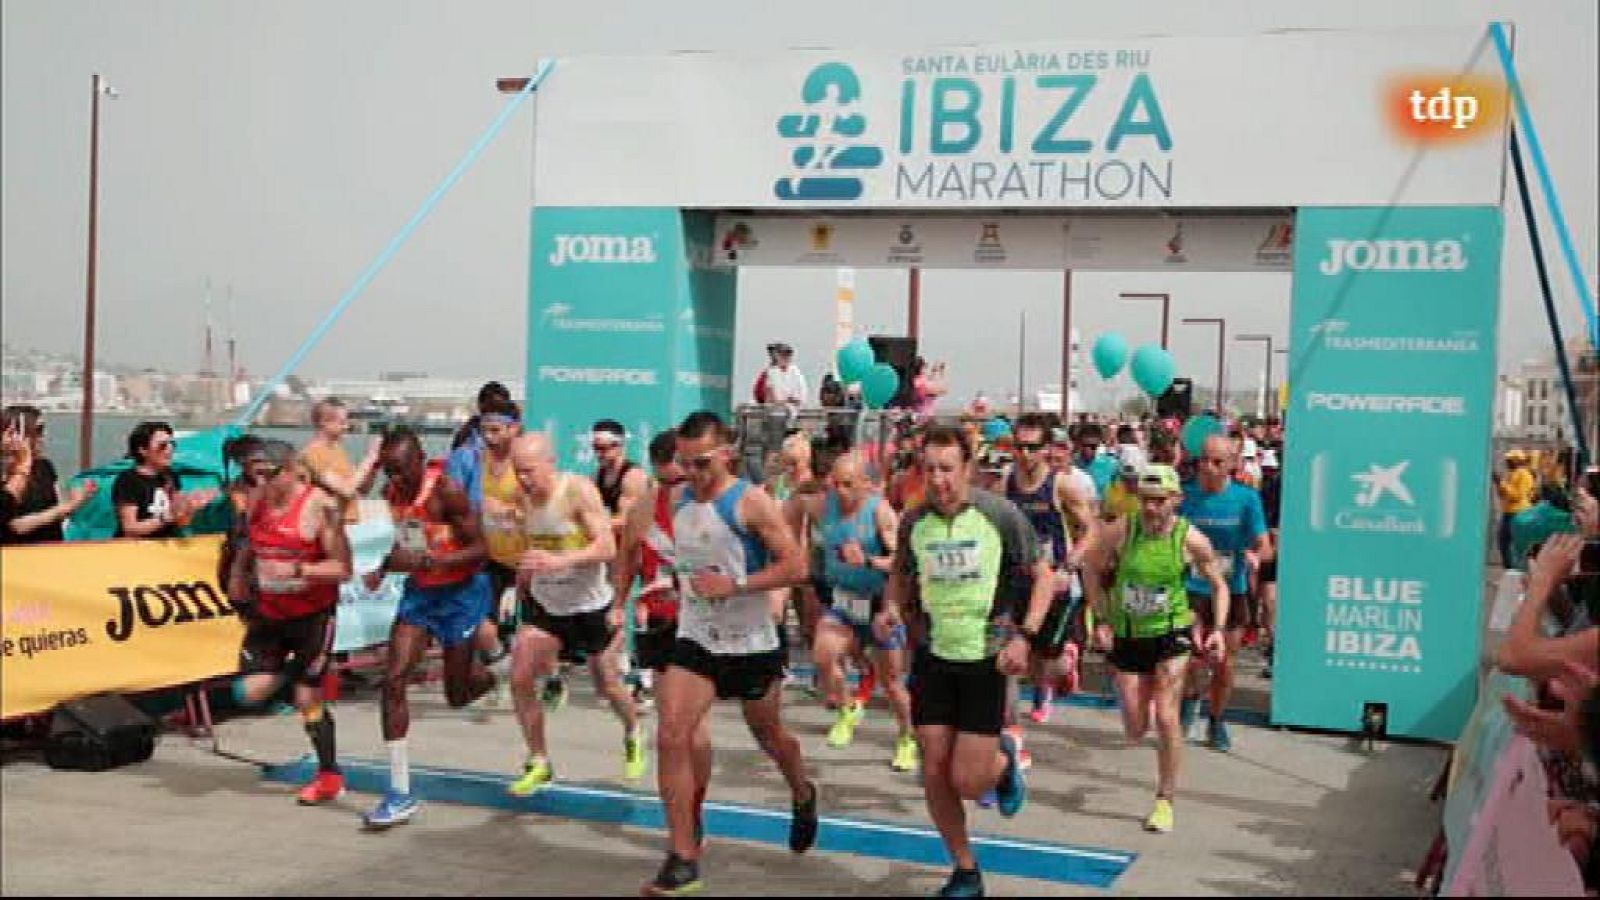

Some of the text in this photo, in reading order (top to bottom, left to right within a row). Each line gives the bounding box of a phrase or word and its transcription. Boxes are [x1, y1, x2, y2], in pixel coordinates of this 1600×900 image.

[902, 49, 1151, 75] SANTA EULÀRIA DES RIU
[900, 72, 1173, 154] IBIZA
[897, 158, 1174, 200] MARATHON
[1307, 393, 1466, 415] POWERADE
[1328, 576, 1423, 604] BLUE
[1326, 604, 1423, 631] MARLIN
[1326, 631, 1423, 661] IBIZA
